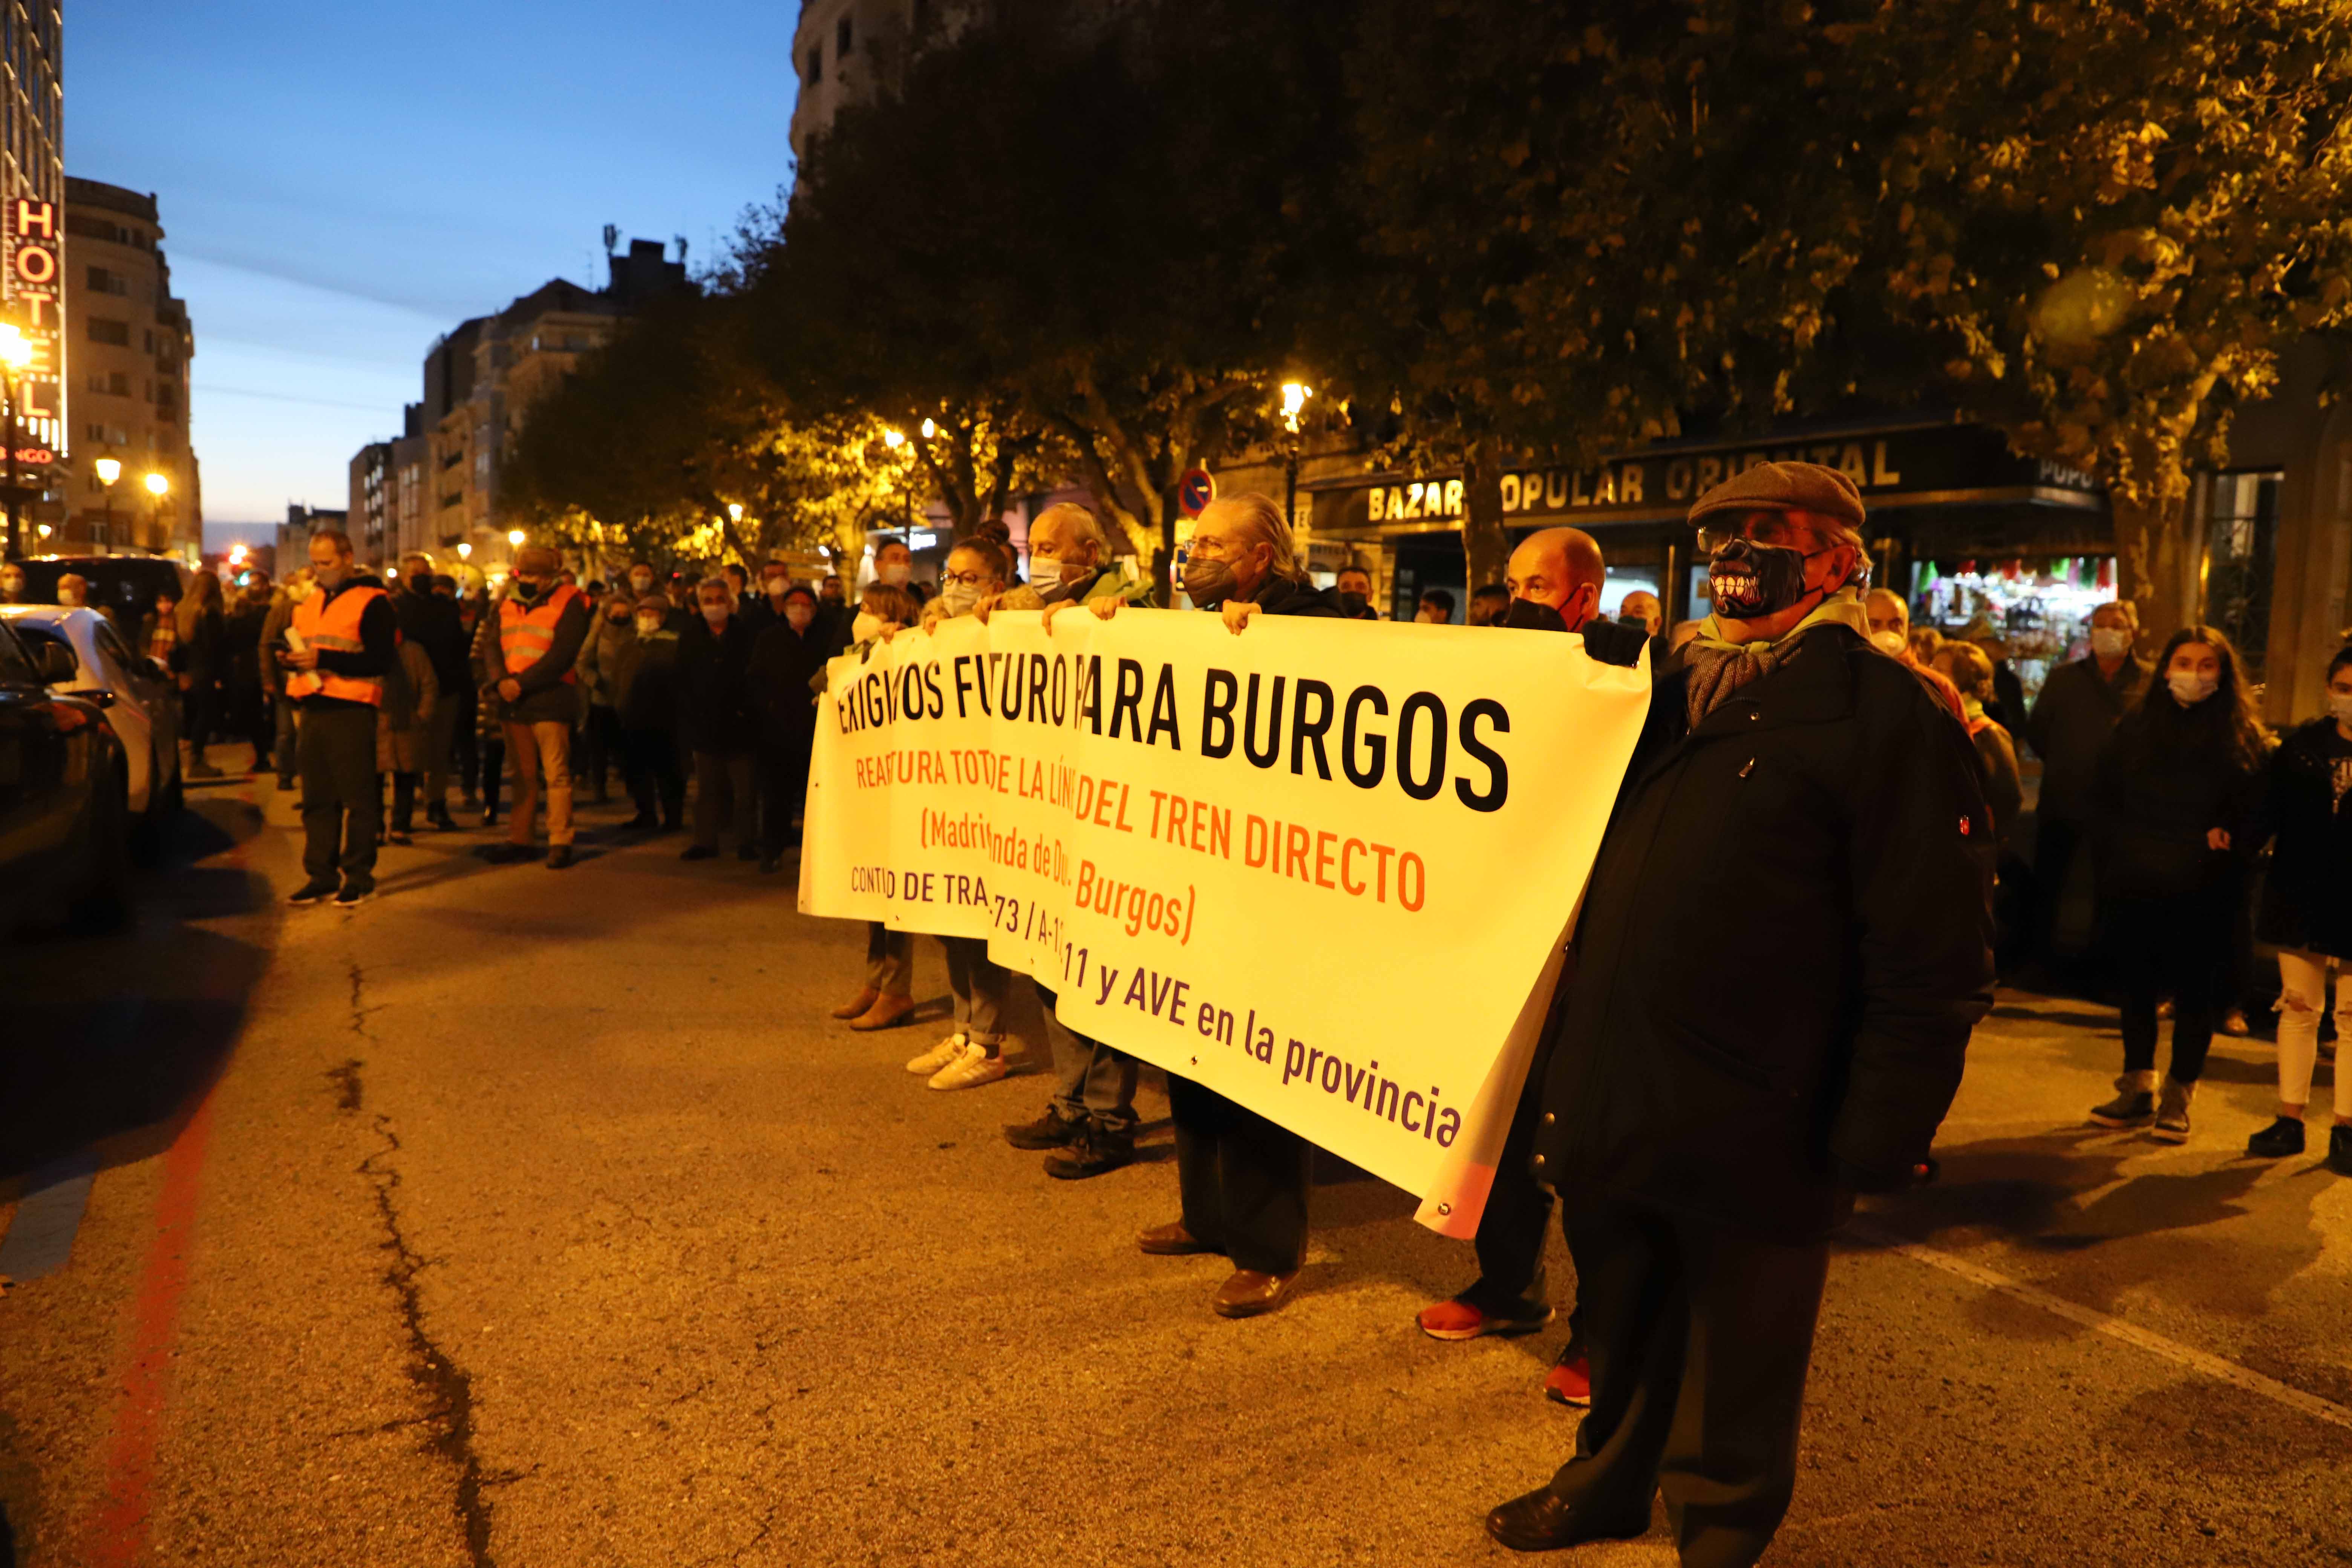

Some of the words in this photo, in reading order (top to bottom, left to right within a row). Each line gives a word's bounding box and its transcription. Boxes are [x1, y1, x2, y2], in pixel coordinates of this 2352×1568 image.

[17, 199, 54, 416] HOTEL
[1368, 479, 1463, 521] BAZAR
[1500, 465, 1644, 513] OPULAR
[1201, 668, 1510, 813] BURGOS
[1019, 758, 1044, 801] LA
[1076, 775, 1133, 832] DEL
[1150, 790, 1231, 860] TREN
[1245, 814, 1425, 912] DIRECTO
[1034, 833, 1050, 877] de
[1075, 860, 1195, 946] Burgos)
[903, 872, 935, 902] DE
[1095, 965, 1119, 1006] y
[1123, 966, 1190, 1027] AVE
[1197, 1002, 1234, 1047] en
[1245, 1009, 1275, 1065] la
[1282, 1038, 1461, 1148] provincia
